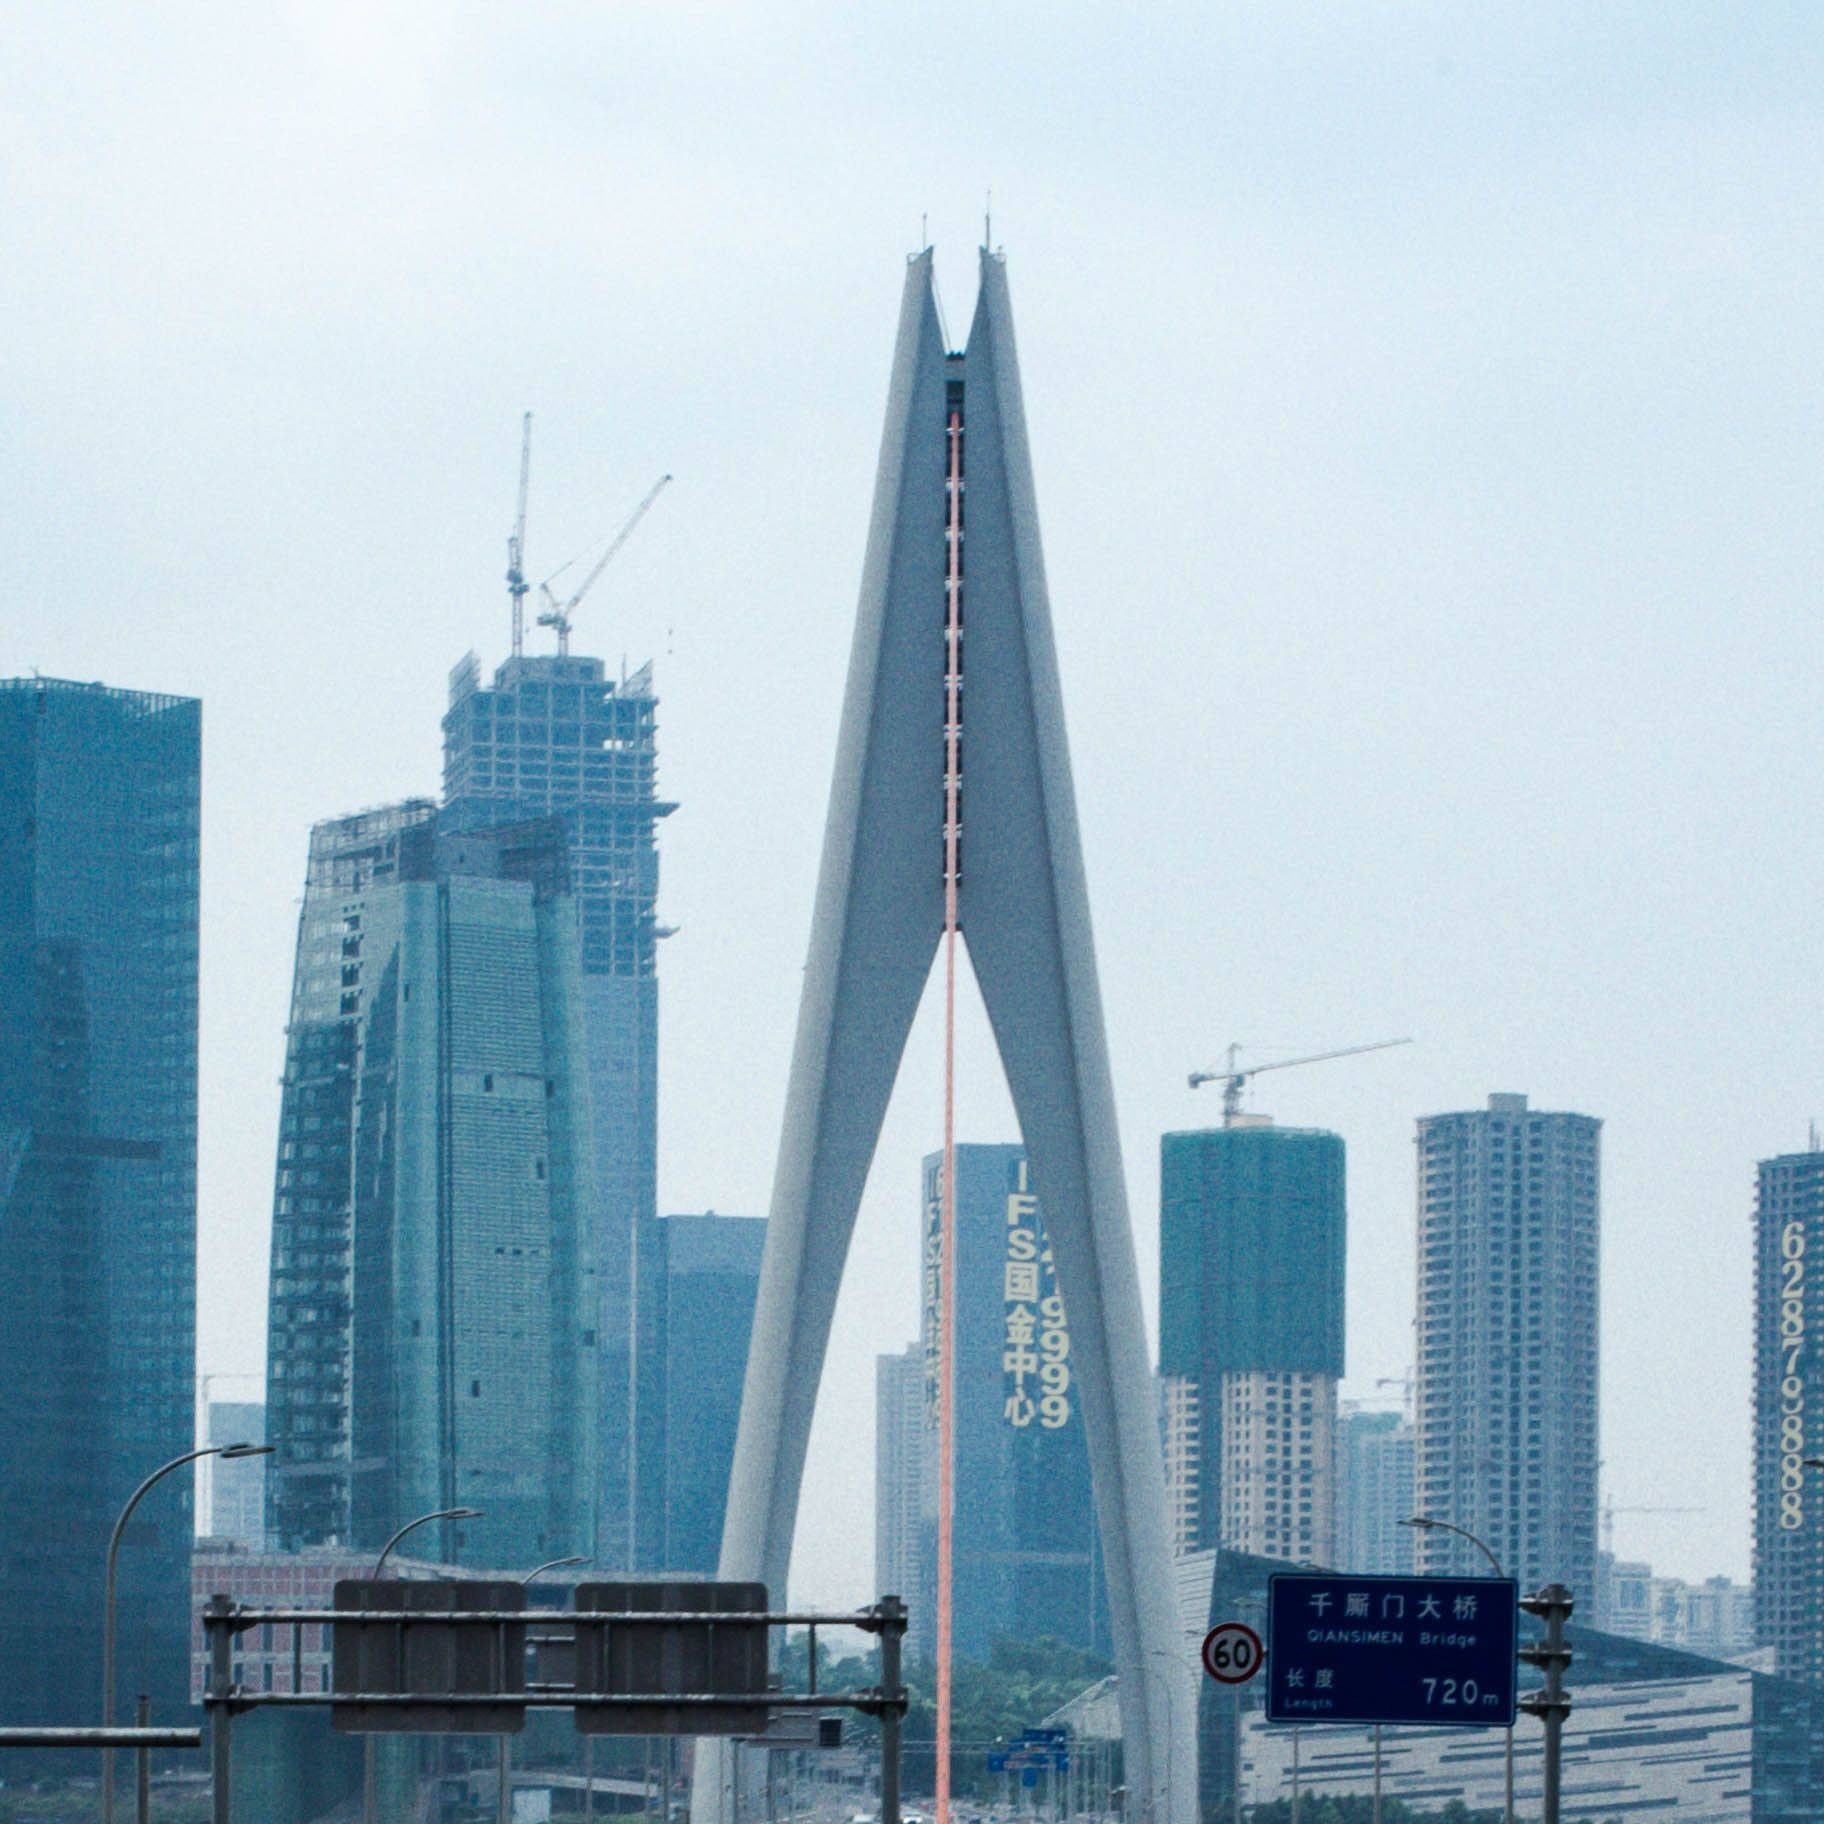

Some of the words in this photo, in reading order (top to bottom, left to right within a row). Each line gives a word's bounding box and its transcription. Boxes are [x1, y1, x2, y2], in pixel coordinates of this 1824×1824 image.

[1003, 1160, 1039, 1428] IFS国金中心
[1308, 1592, 1479, 1620] 千厮门大桥
[1307, 1629, 1404, 1645] QIANSIMEN
[1419, 1631, 1478, 1648] Bridge
[1214, 1638, 1251, 1668] 60
[1285, 1668, 1334, 1688] 长度
[1422, 1678, 1478, 1704] 720
